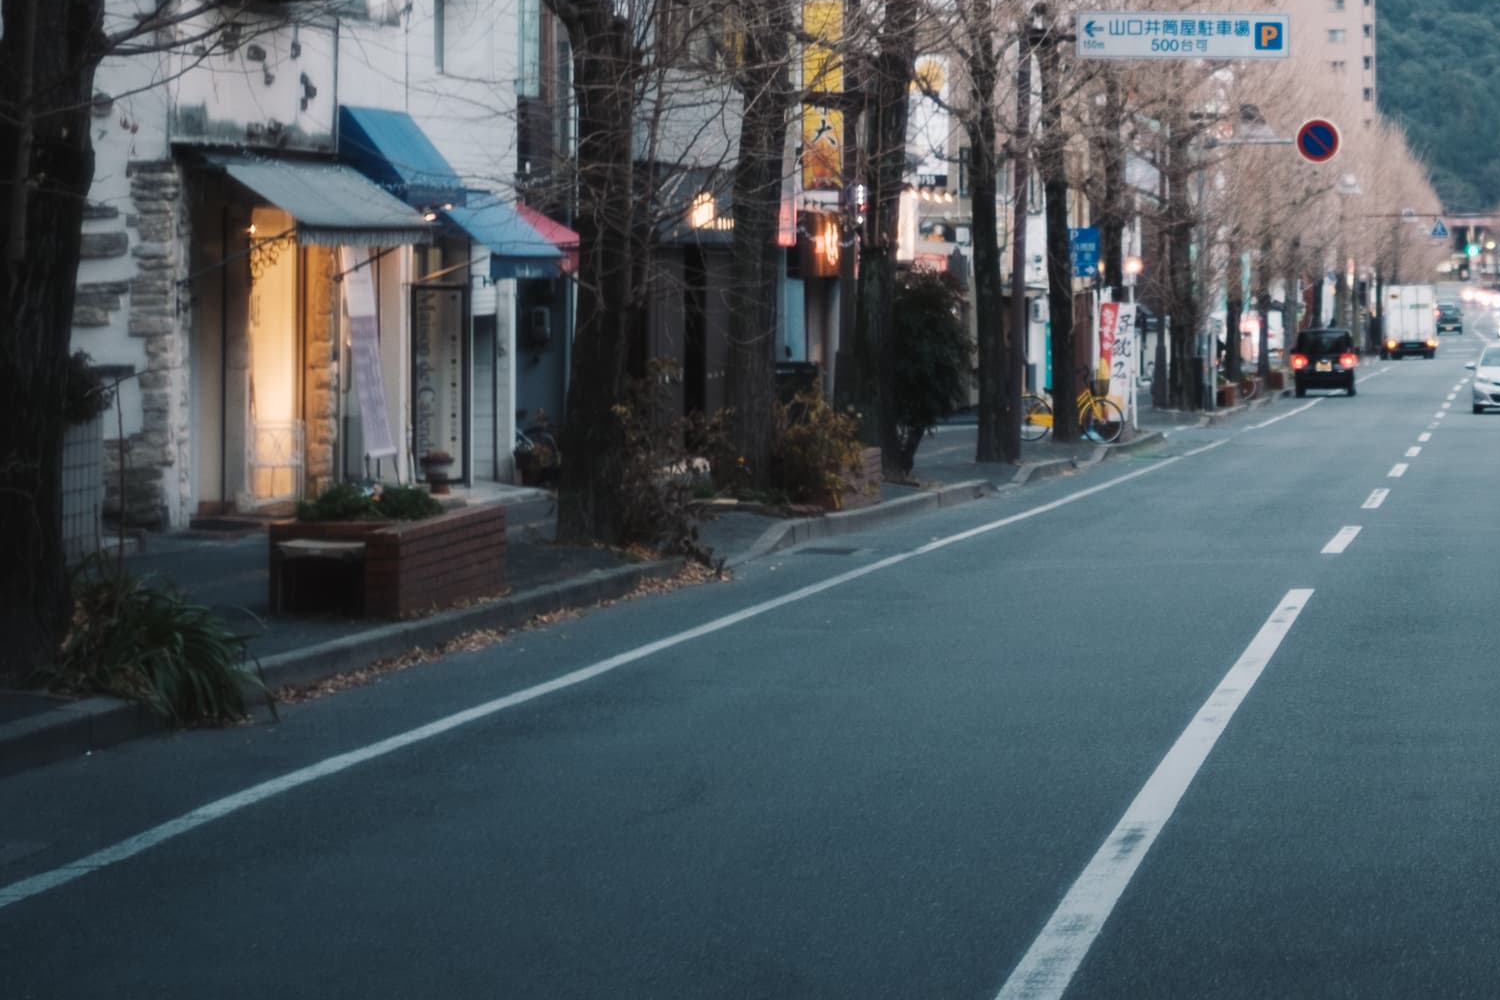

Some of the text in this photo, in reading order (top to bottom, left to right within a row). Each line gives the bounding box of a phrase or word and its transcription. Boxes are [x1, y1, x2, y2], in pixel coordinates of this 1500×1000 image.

[1108, 18, 1250, 37] 山口井筒屋駐車場
[1261, 25, 1278, 47] P
